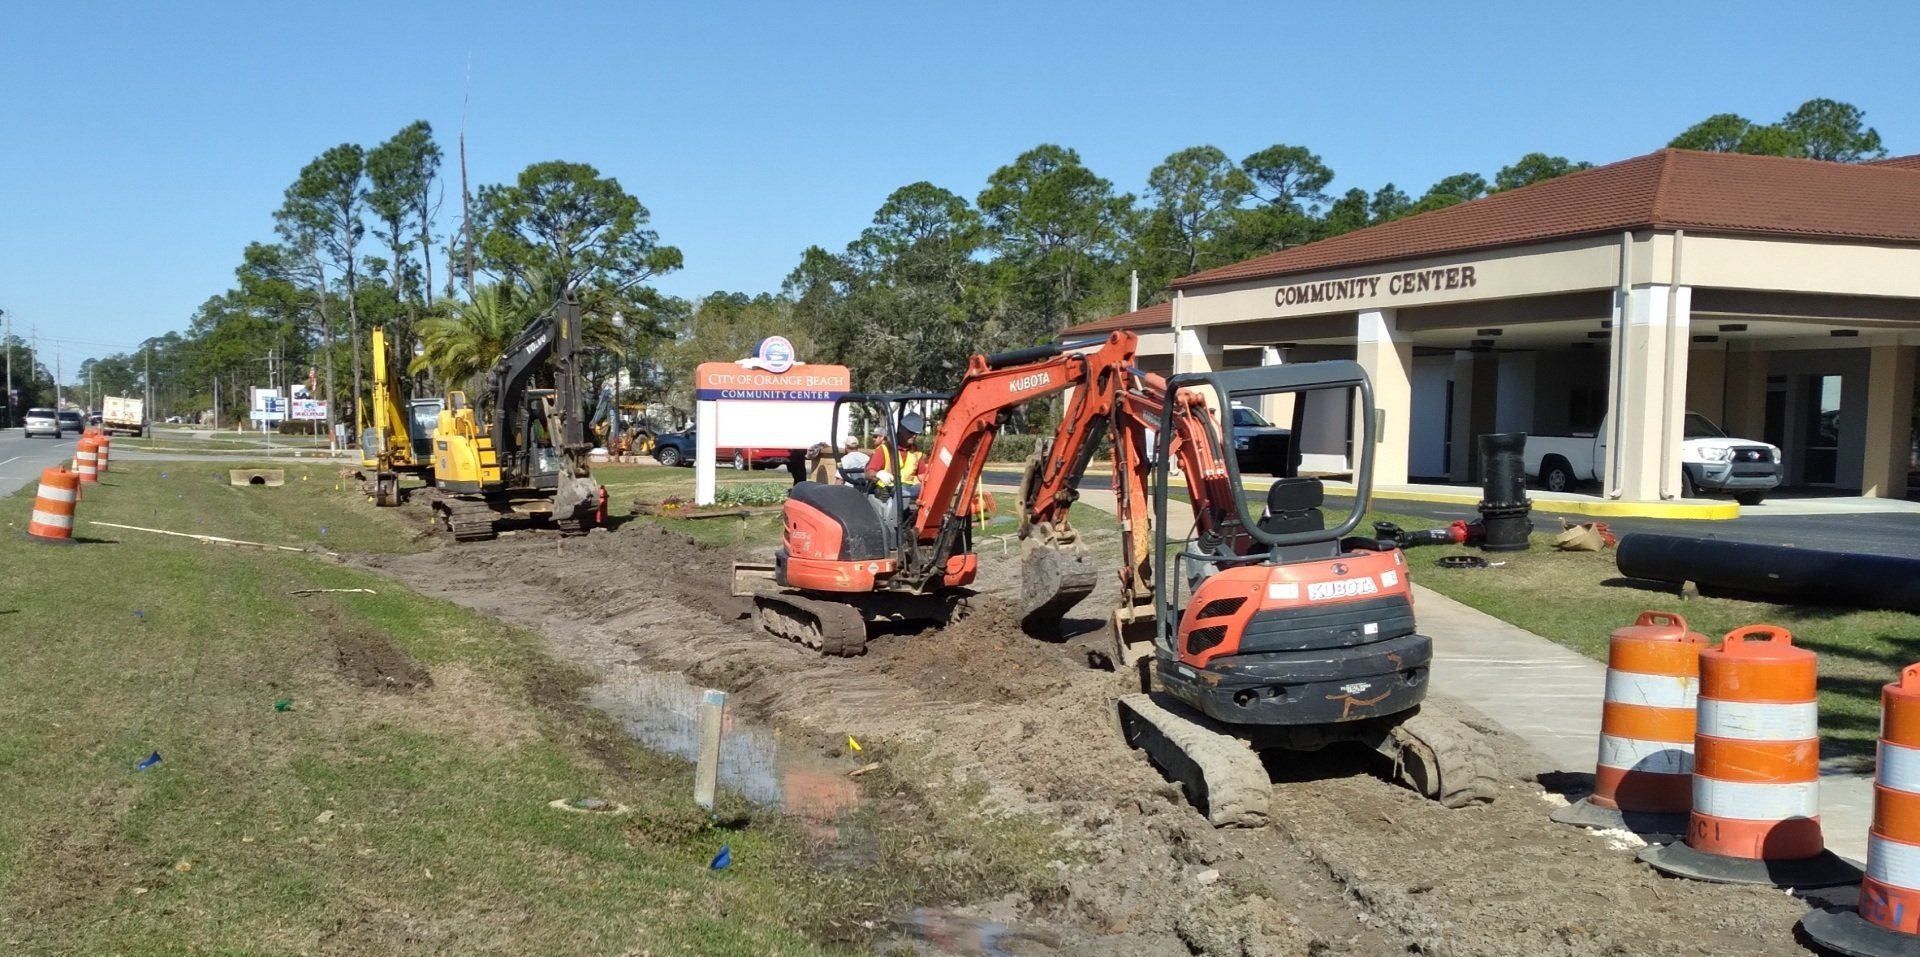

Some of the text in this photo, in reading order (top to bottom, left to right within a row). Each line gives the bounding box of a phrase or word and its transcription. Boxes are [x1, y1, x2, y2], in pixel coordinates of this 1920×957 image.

[1275, 265, 1477, 307] COMMUNITY CENTER
[525, 334, 547, 354] VOLVO
[708, 374, 844, 388] CITY OF ORANGE BEACH
[1009, 372, 1051, 393] KUBOTA
[721, 389, 830, 400] COMMUNITY CENTER
[1309, 578, 1377, 600] KUBOTA
